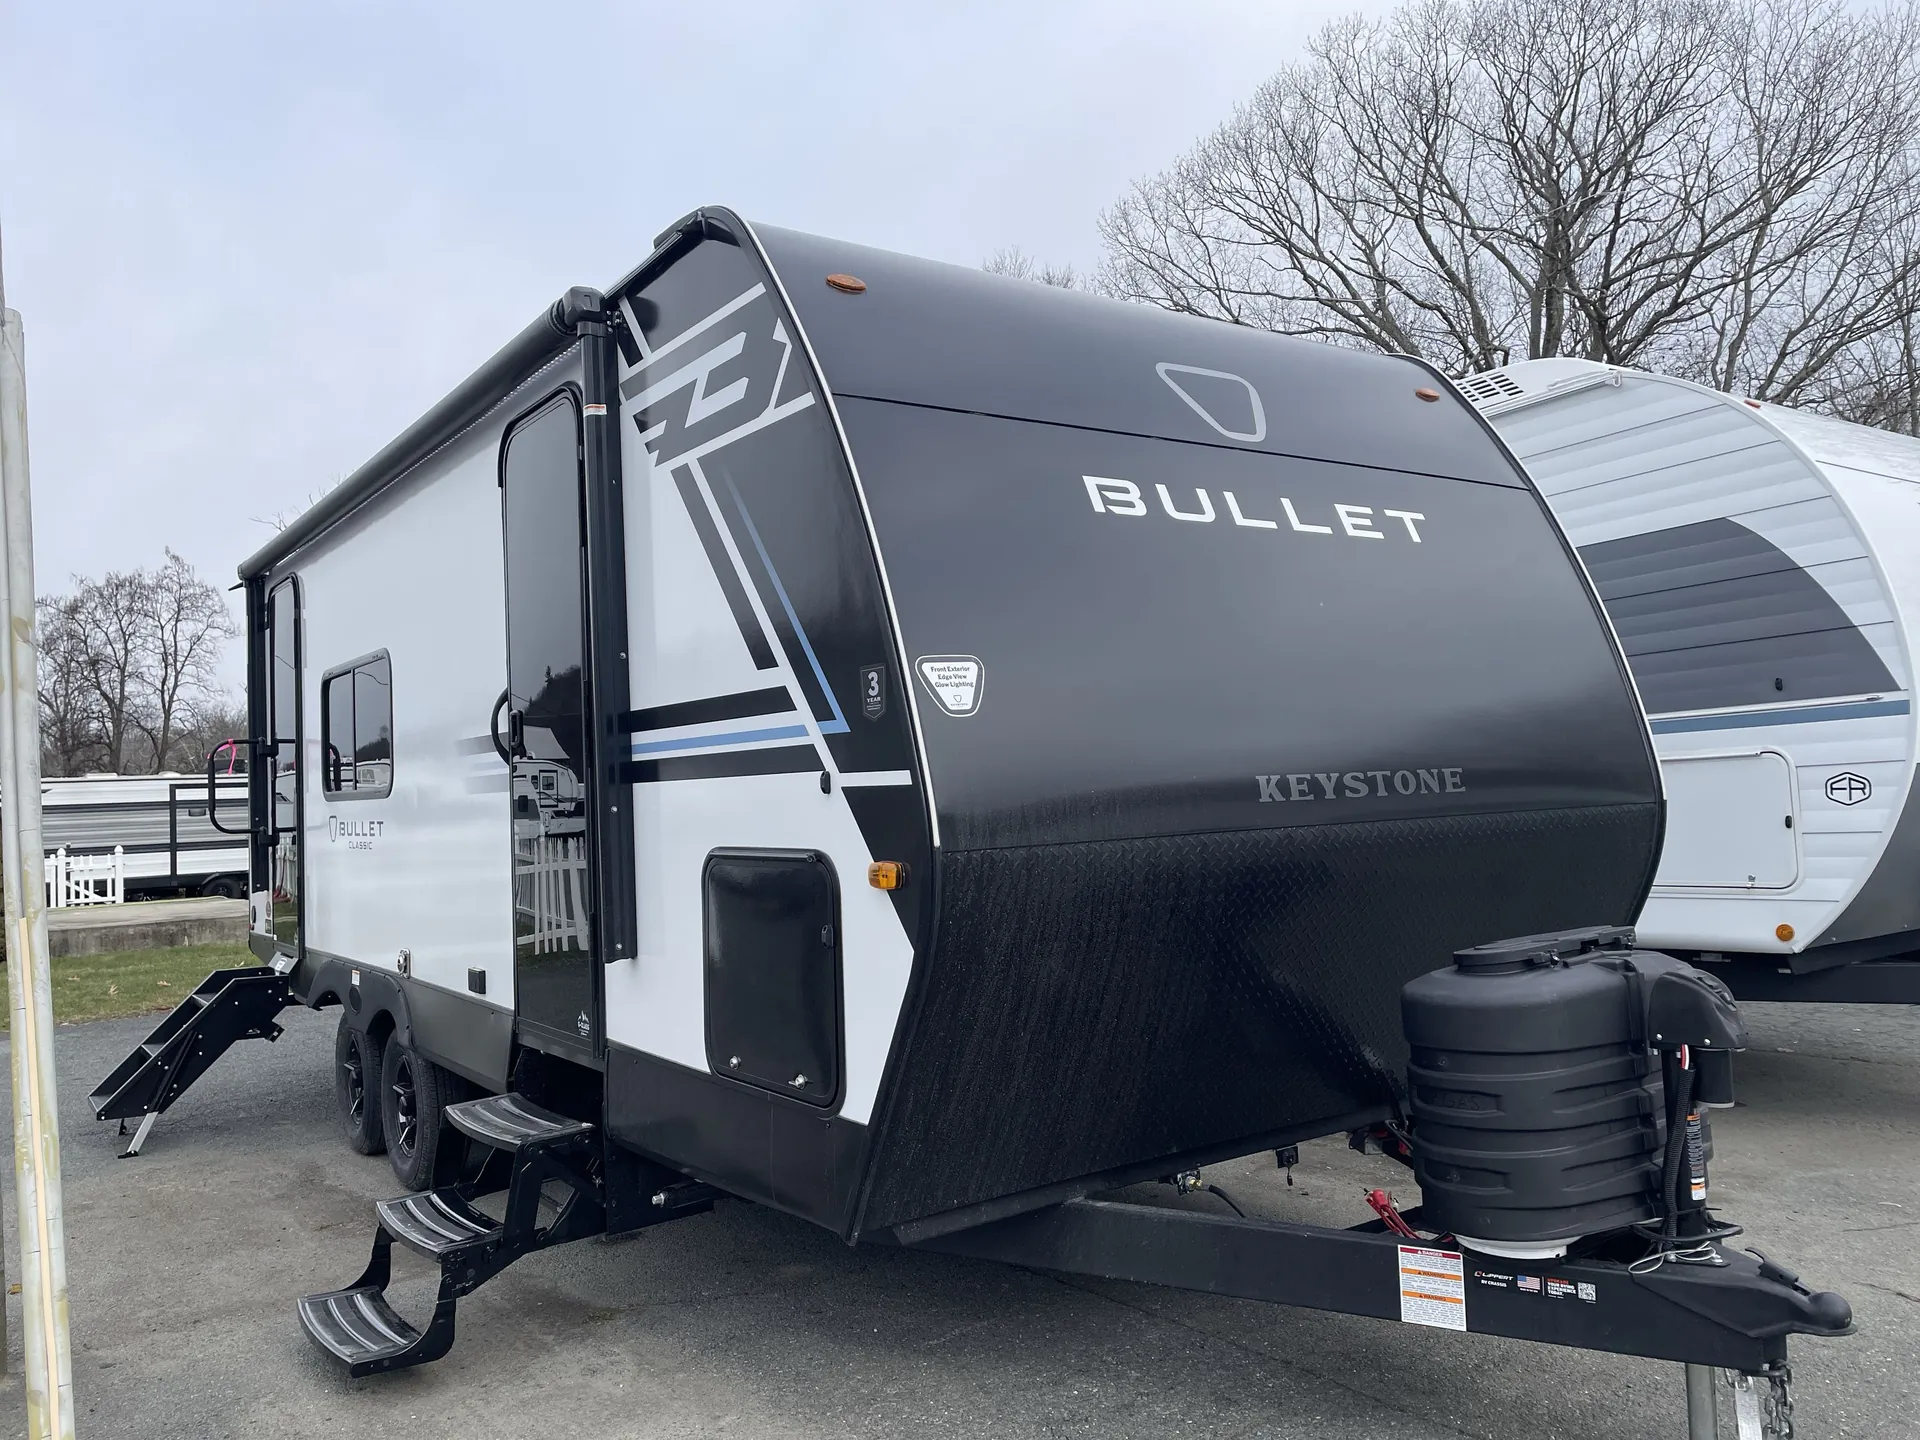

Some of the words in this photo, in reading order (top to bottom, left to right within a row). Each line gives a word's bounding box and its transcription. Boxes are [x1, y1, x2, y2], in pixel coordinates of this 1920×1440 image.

[1082, 475, 1426, 543] BULLET
[868, 671, 879, 696] 3
[1255, 767, 1466, 802] KEYSTONE
[339, 821, 384, 837] BULLET
[348, 841, 372, 850] CLASSIC
[1482, 1272, 1514, 1281] LIPPERT
[1488, 1280, 1507, 1288] CHASSIS
